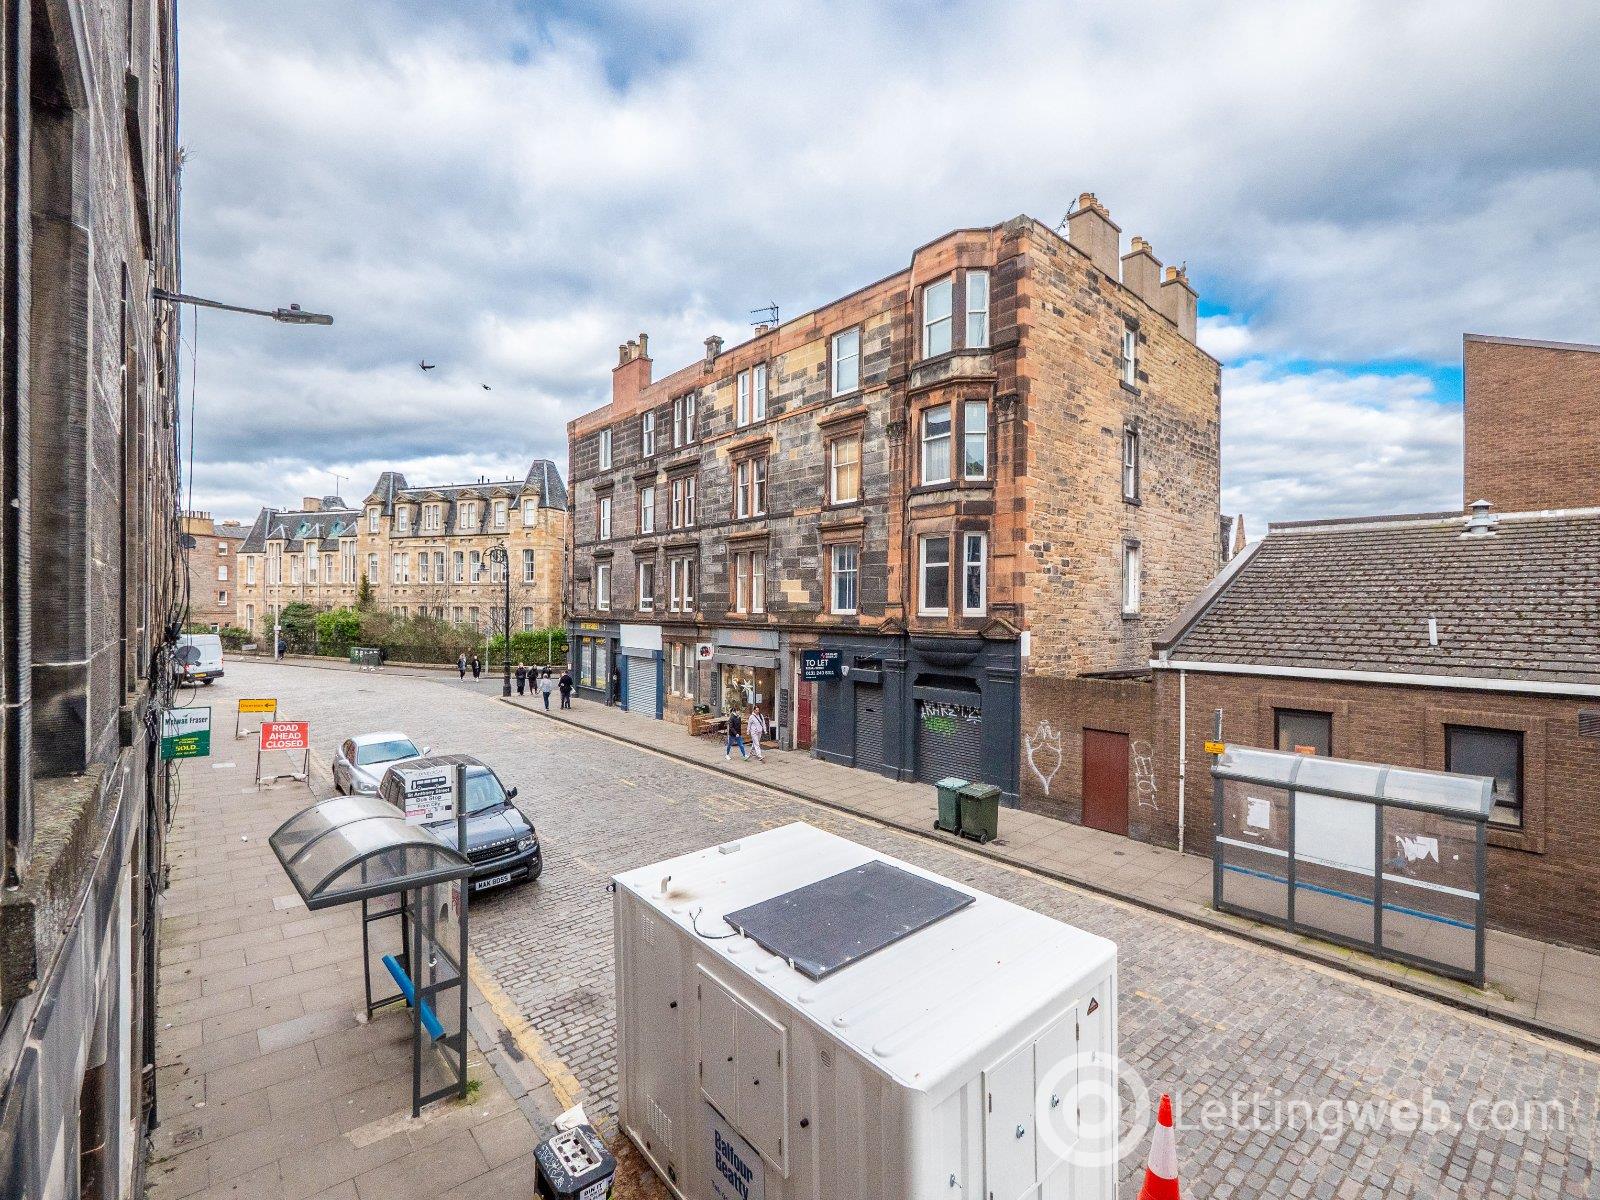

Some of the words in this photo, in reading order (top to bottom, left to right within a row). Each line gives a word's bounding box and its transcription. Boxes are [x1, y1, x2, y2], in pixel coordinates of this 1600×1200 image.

[805, 659, 816, 667] TO
[817, 659, 829, 667] LET
[189, 716, 208, 724] Fraser
[271, 724, 299, 732] ROAD
[269, 732, 302, 740] AHEAD
[175, 744, 197, 752] SOLD
[265, 740, 304, 749] CLOSED
[714, 1128, 754, 1184] Balfour
[715, 1149, 749, 1200] Beatty
